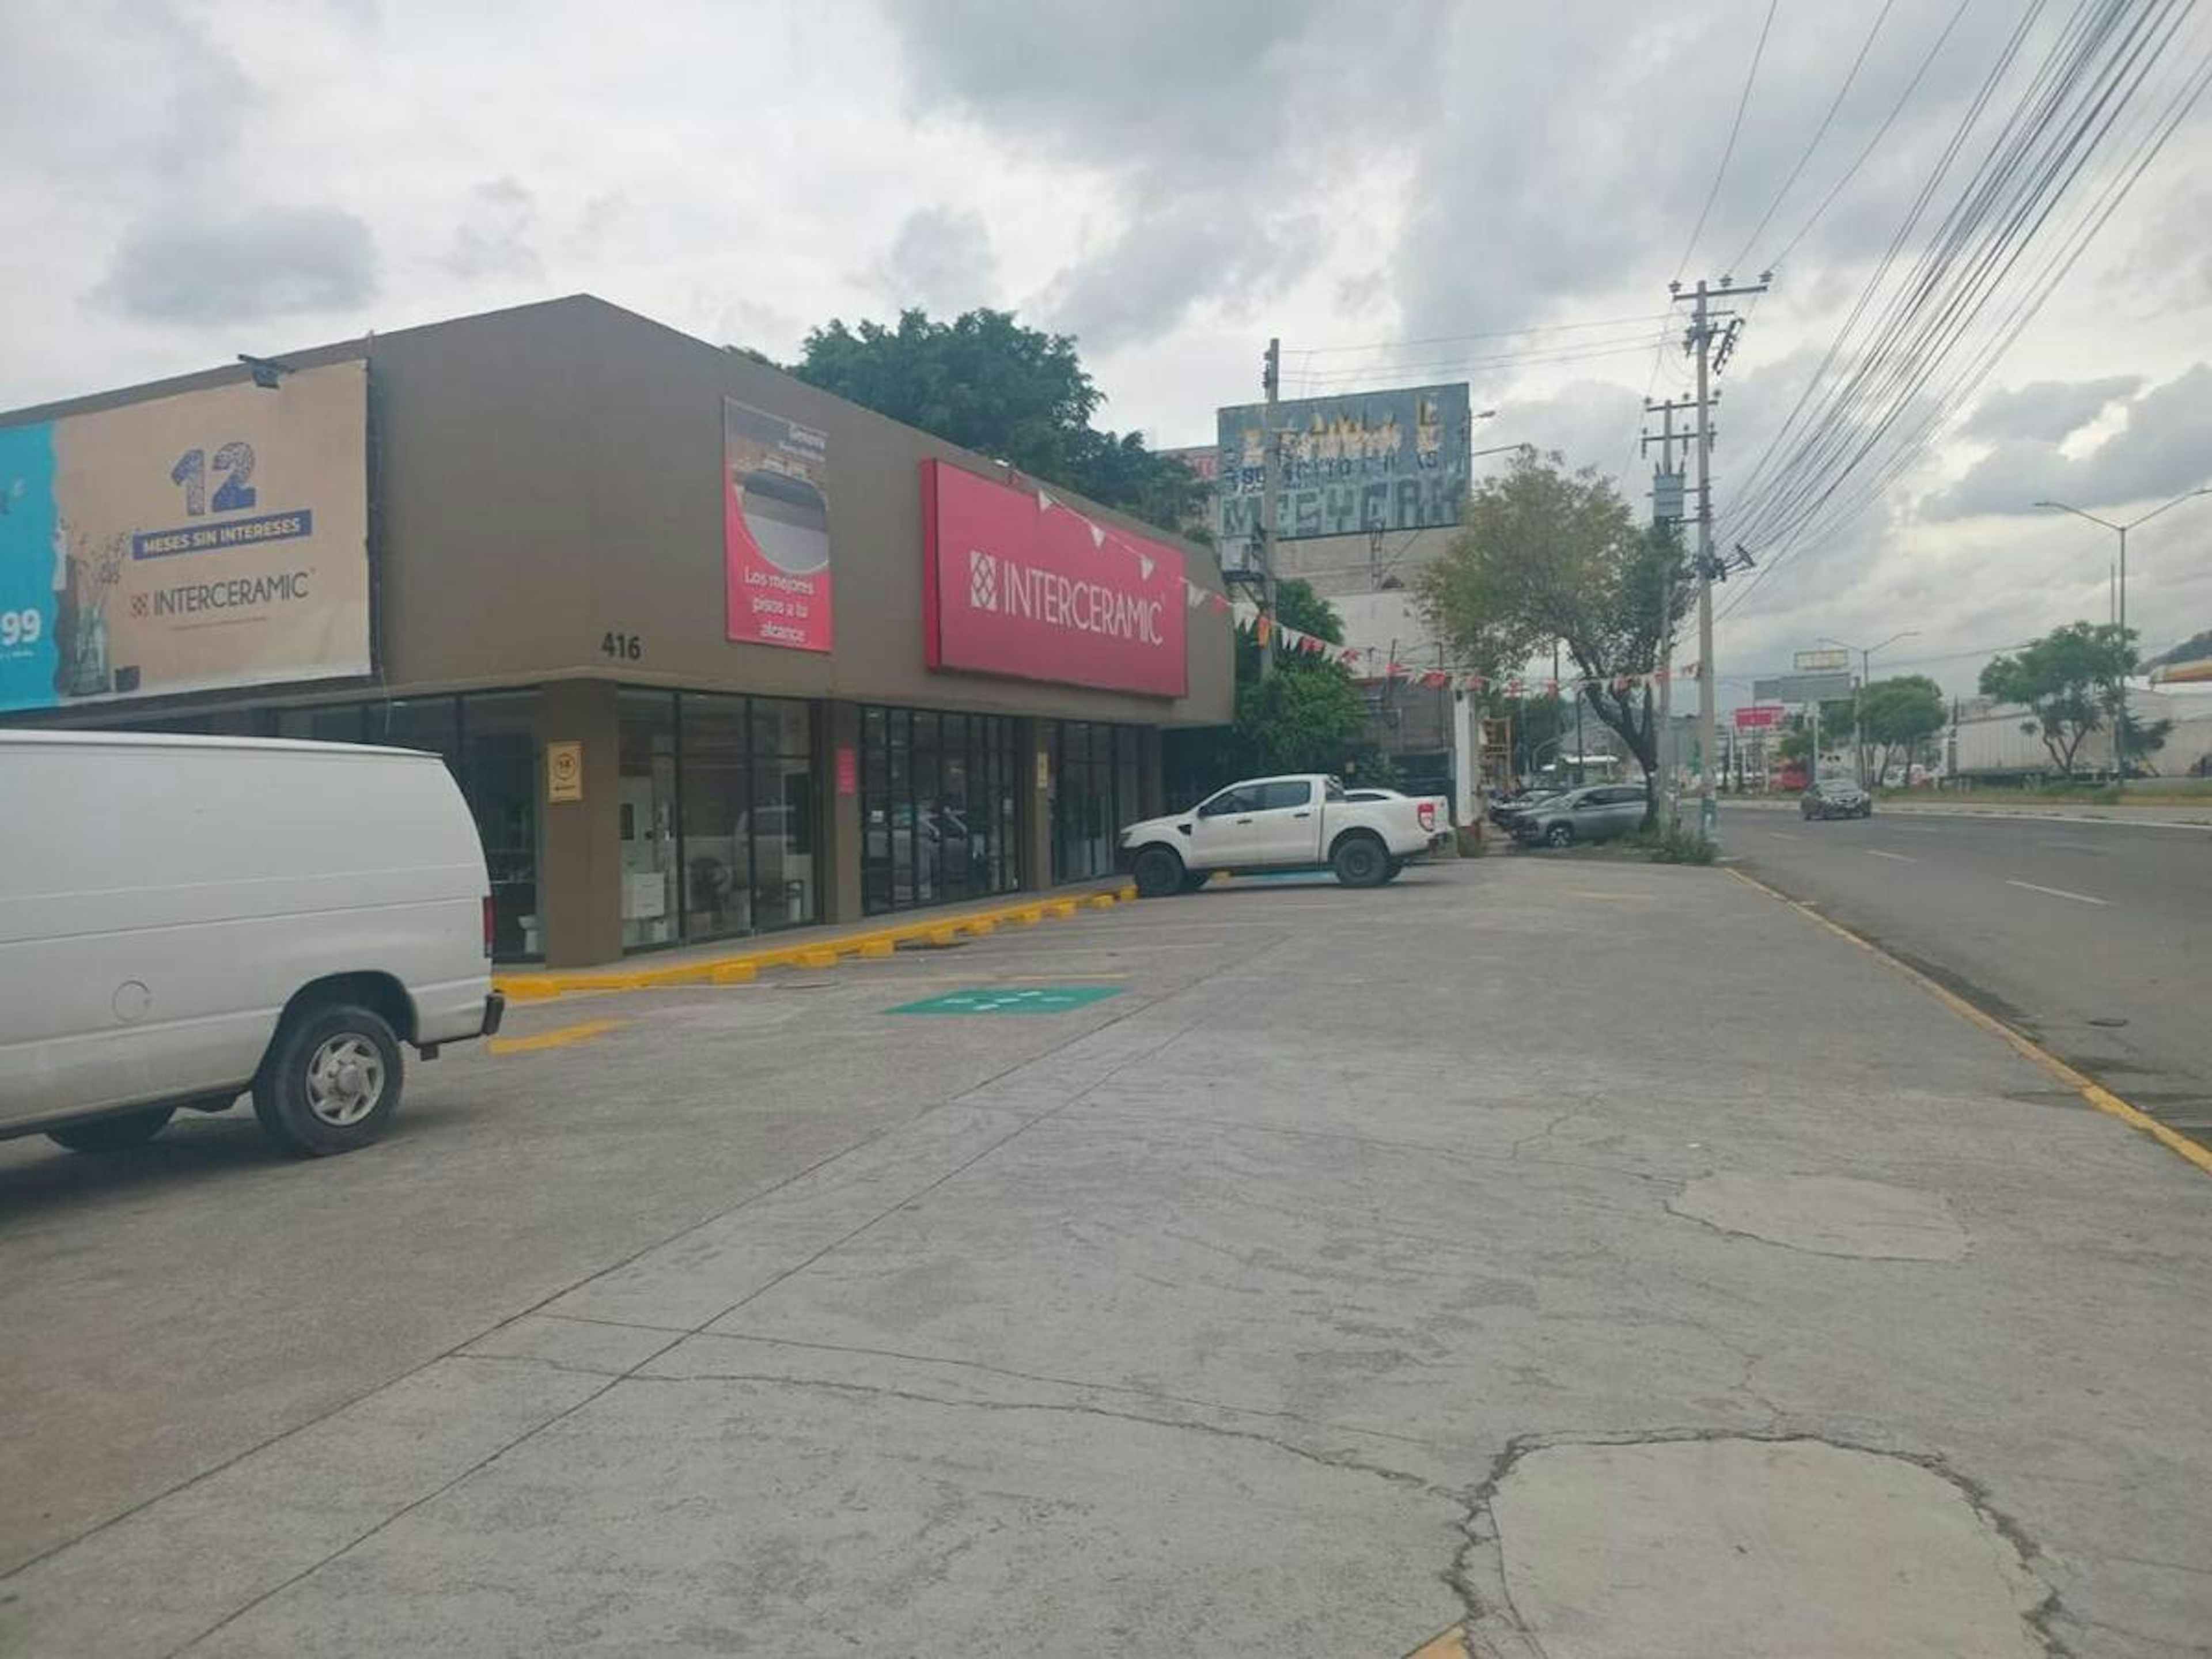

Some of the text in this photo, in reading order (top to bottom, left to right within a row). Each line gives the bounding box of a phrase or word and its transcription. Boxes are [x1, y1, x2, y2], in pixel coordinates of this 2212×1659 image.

[171, 441, 256, 516] 12
[143, 518, 301, 554] MESES SIN INTERESES
[153, 572, 309, 616] INTERCERAMIC
[744, 566, 768, 586] Los
[1003, 560, 1164, 646] INTERCERAMIC
[602, 632, 641, 660] 416
